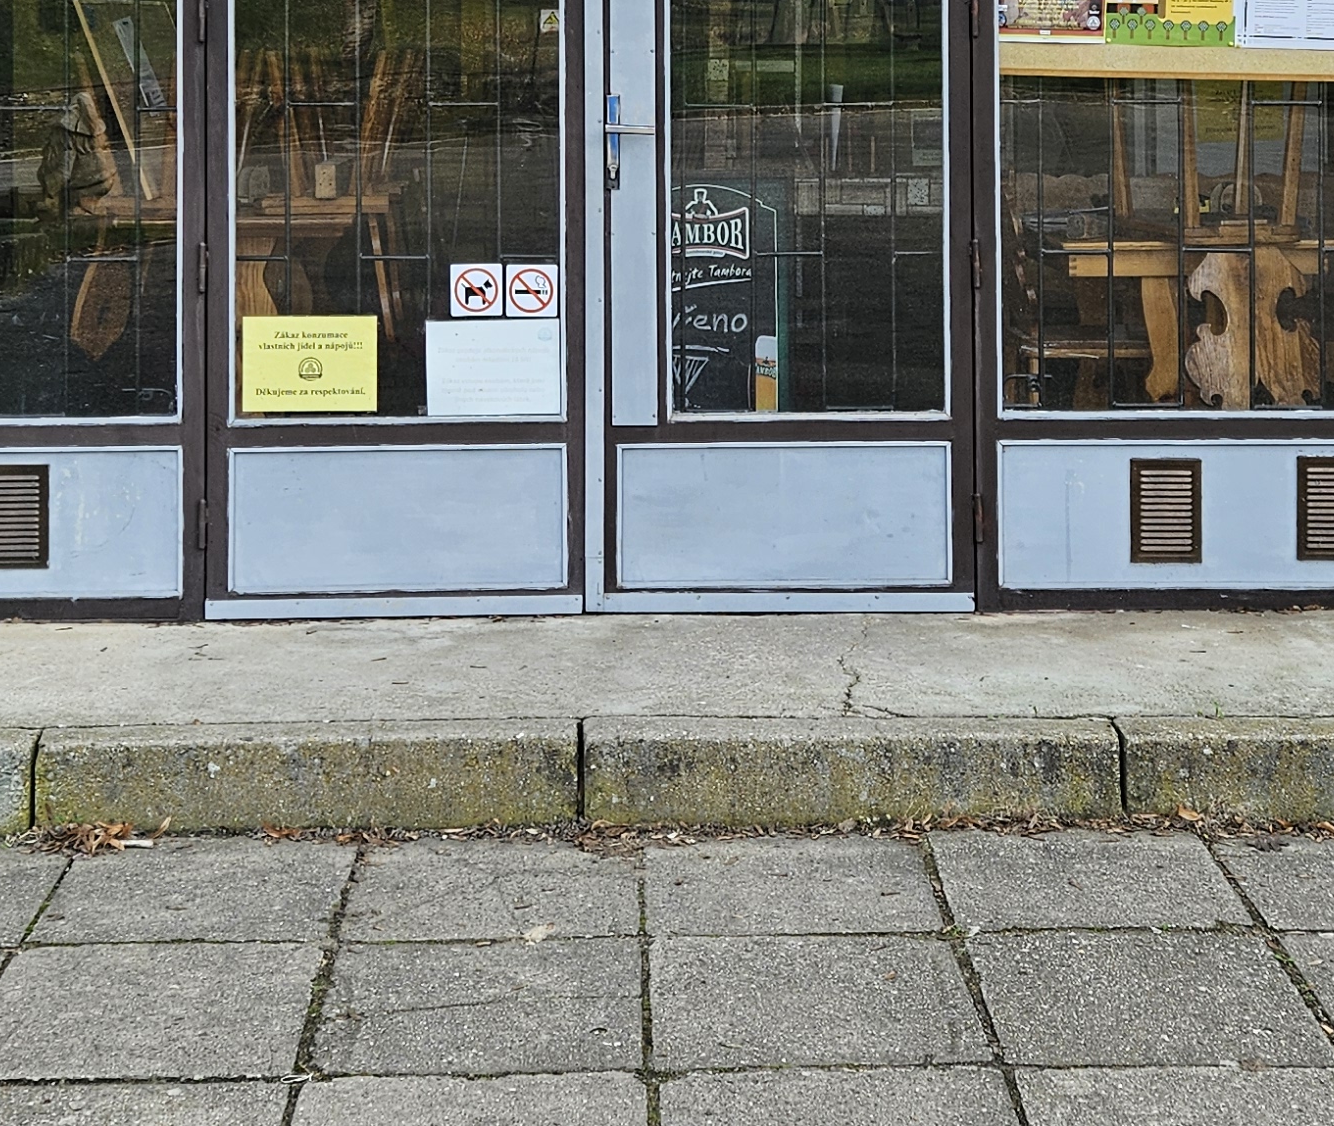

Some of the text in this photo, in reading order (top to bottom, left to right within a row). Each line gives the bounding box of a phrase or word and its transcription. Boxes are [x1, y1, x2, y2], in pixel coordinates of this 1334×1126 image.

[671, 218, 744, 250] AMBOR
[709, 264, 752, 278] Tambora
[274, 331, 348, 339] Zákaz konzumace
[259, 342, 295, 350] vlastních
[297, 342, 316, 351] jídel
[325, 341, 363, 351] nápojů!!!
[255, 388, 297, 397] Děkujeme
[311, 387, 366, 397] respektování.
